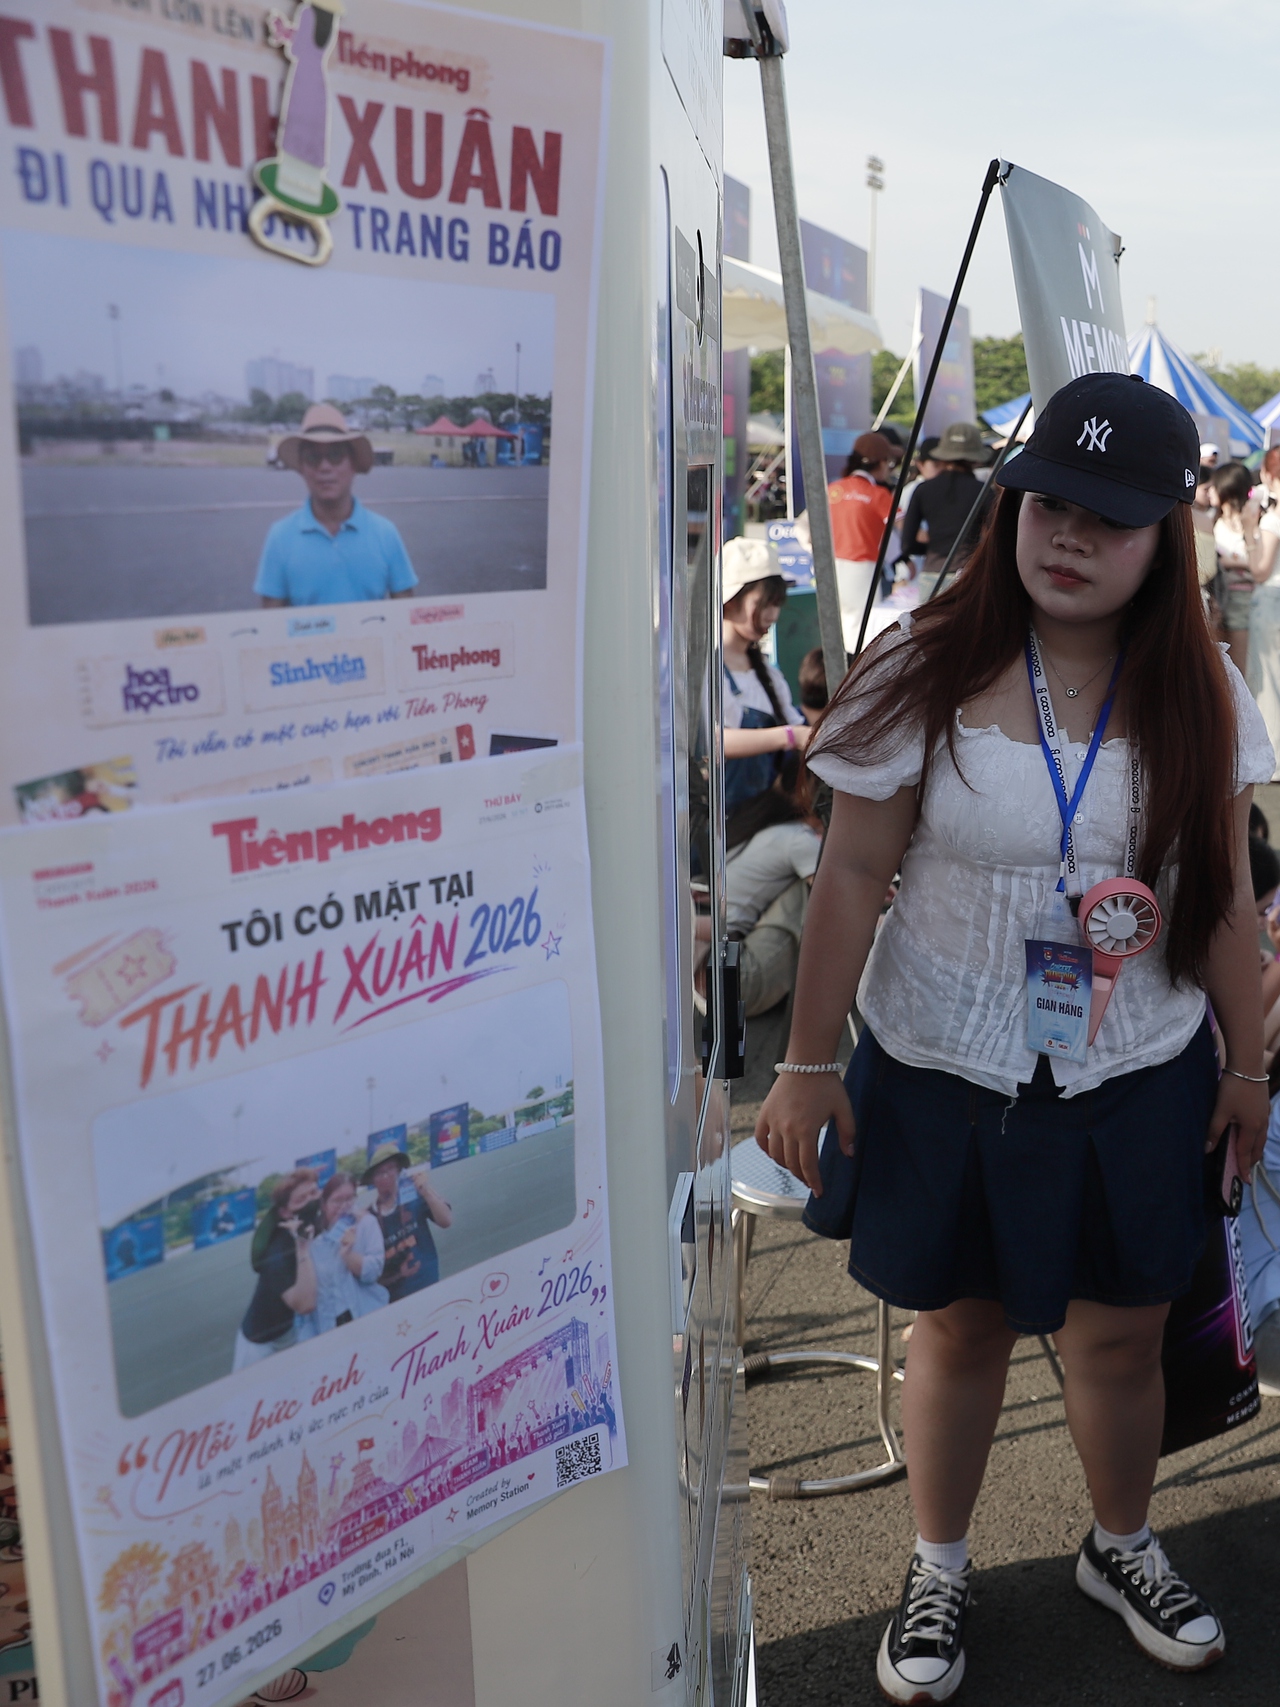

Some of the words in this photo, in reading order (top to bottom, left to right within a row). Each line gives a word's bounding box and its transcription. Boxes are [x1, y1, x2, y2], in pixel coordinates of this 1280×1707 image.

[338, 95, 563, 217] XUÂN
[16, 146, 70, 208] ĐI
[89, 160, 175, 225] QUA
[347, 203, 470, 263] TRANG
[488, 219, 562, 272] BÁO
[192, 730, 228, 756] vẫn
[233, 729, 255, 750] có
[260, 722, 297, 747] một
[301, 716, 339, 740] cuộc
[343, 711, 372, 733] hẹn
[376, 704, 401, 724] với
[442, 691, 489, 714] Phong
[221, 909, 283, 953] TÔI
[294, 892, 344, 937] CÓ
[354, 880, 421, 923] MẶT
[429, 870, 474, 908] TẠI
[118, 948, 329, 1090] THANH
[332, 912, 460, 1026] XUÂN
[464, 884, 542, 968] 2026
[1036, 997, 1057, 1014] GIAN
[1058, 999, 1083, 1018] HÀNG
[390, 1331, 472, 1400] Thanh
[472, 1301, 535, 1360] Xuân
[246, 1394, 303, 1442] bức
[310, 1352, 365, 1407] ảnh
[460, 1457, 478, 1472] TEAM
[466, 1481, 499, 1507] Created
[501, 1476, 512, 1491] by
[466, 1497, 499, 1520] Memory
[500, 1481, 531, 1502] Station
[385, 1556, 398, 1571] Hà
[400, 1545, 415, 1562] Nội
